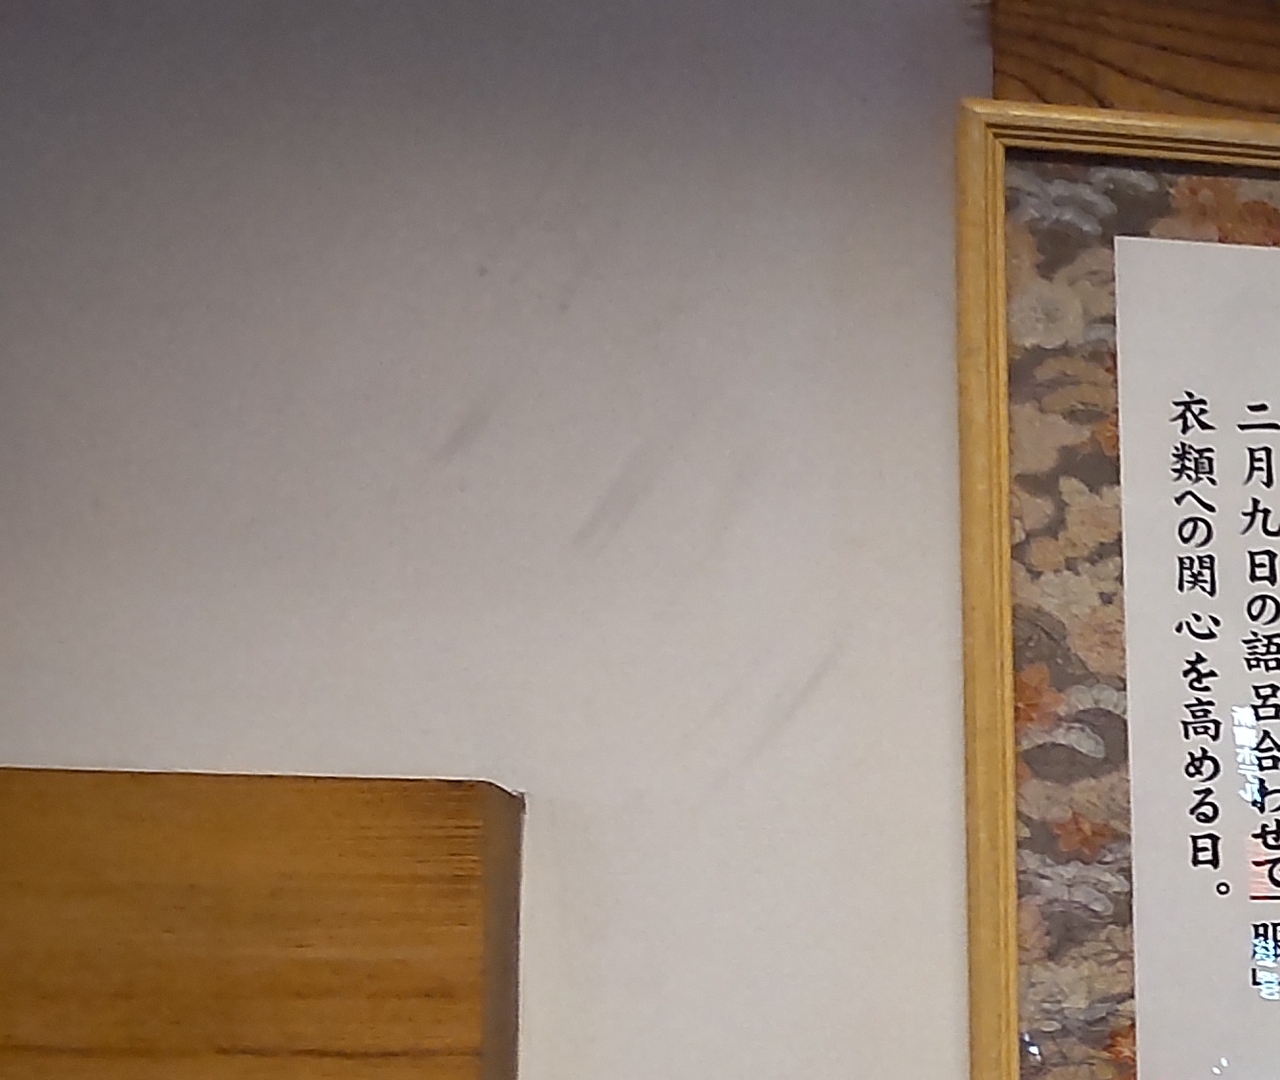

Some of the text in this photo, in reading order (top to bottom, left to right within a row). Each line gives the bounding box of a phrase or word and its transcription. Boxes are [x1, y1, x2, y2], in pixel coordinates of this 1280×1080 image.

[1169, 390, 1231, 896] 衣類への関心を高める日。
